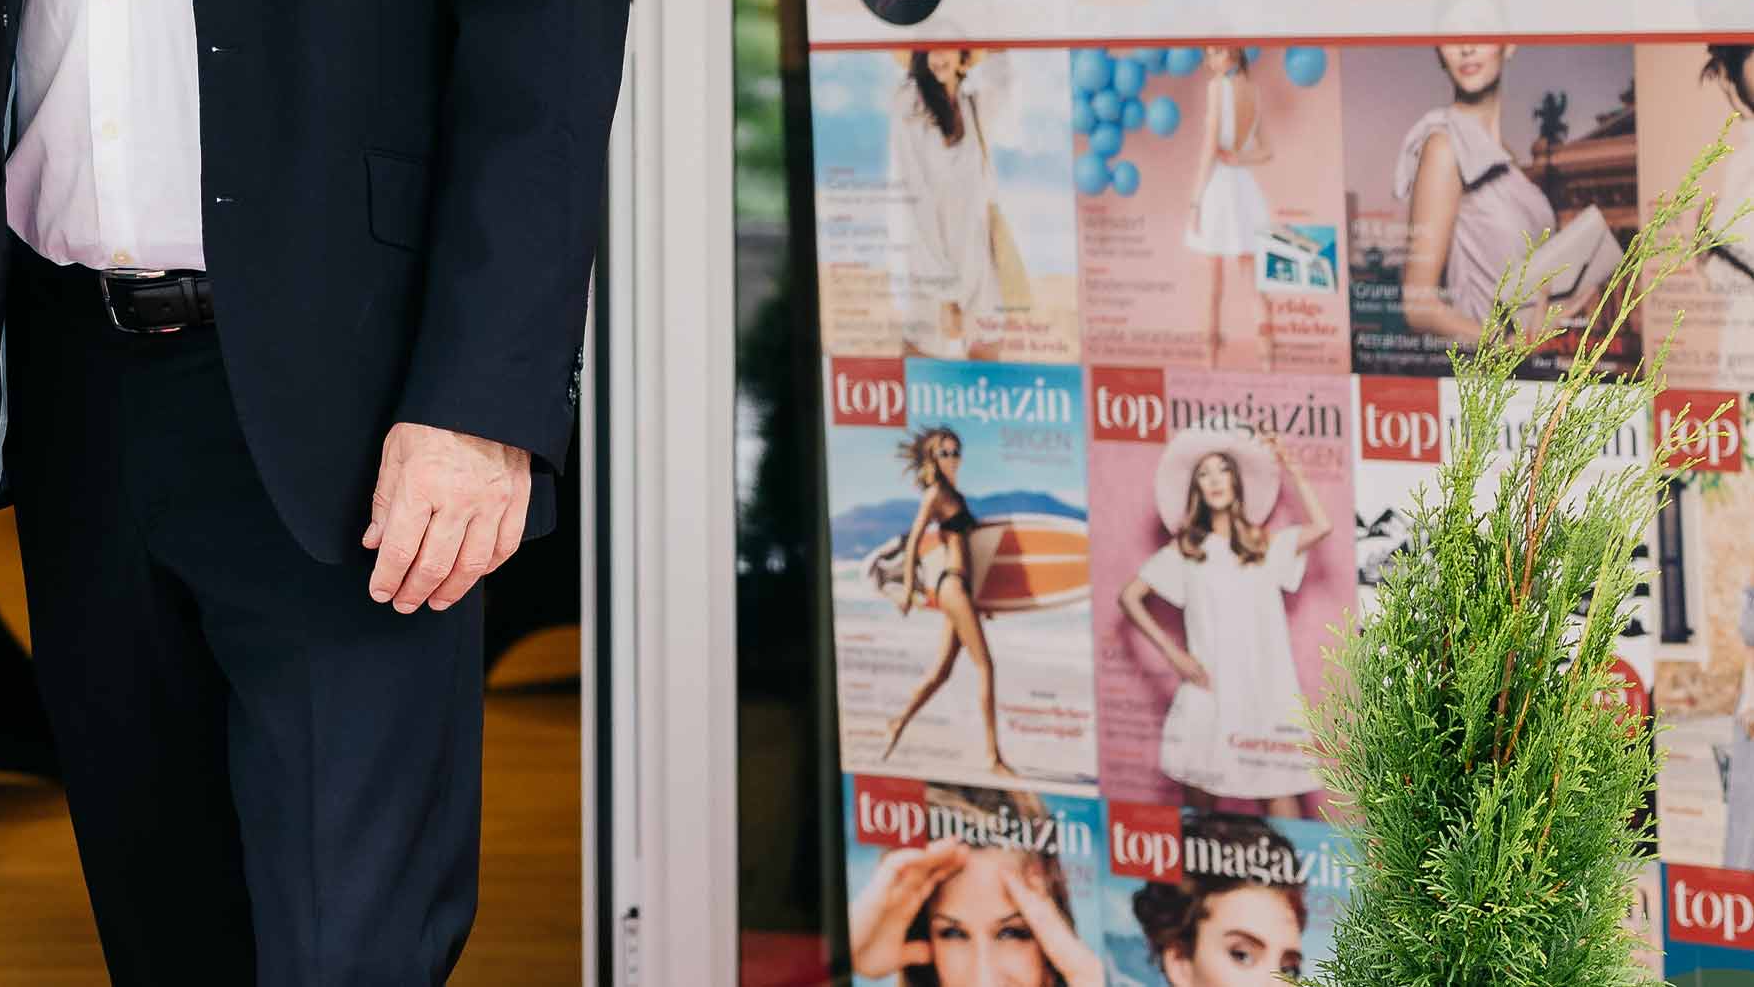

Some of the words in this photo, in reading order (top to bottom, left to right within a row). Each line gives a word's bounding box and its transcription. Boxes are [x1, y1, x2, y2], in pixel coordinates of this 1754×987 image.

[834, 371, 904, 424] top
[908, 375, 1072, 424] magazin
[1096, 385, 1164, 439] top
[1170, 393, 1343, 438] magazin
[1365, 403, 1438, 459] top
[1659, 408, 1740, 466] top
[859, 791, 925, 845] top
[929, 806, 1094, 859] magazin
[1113, 821, 1180, 877] top
[1674, 879, 1754, 942] top
